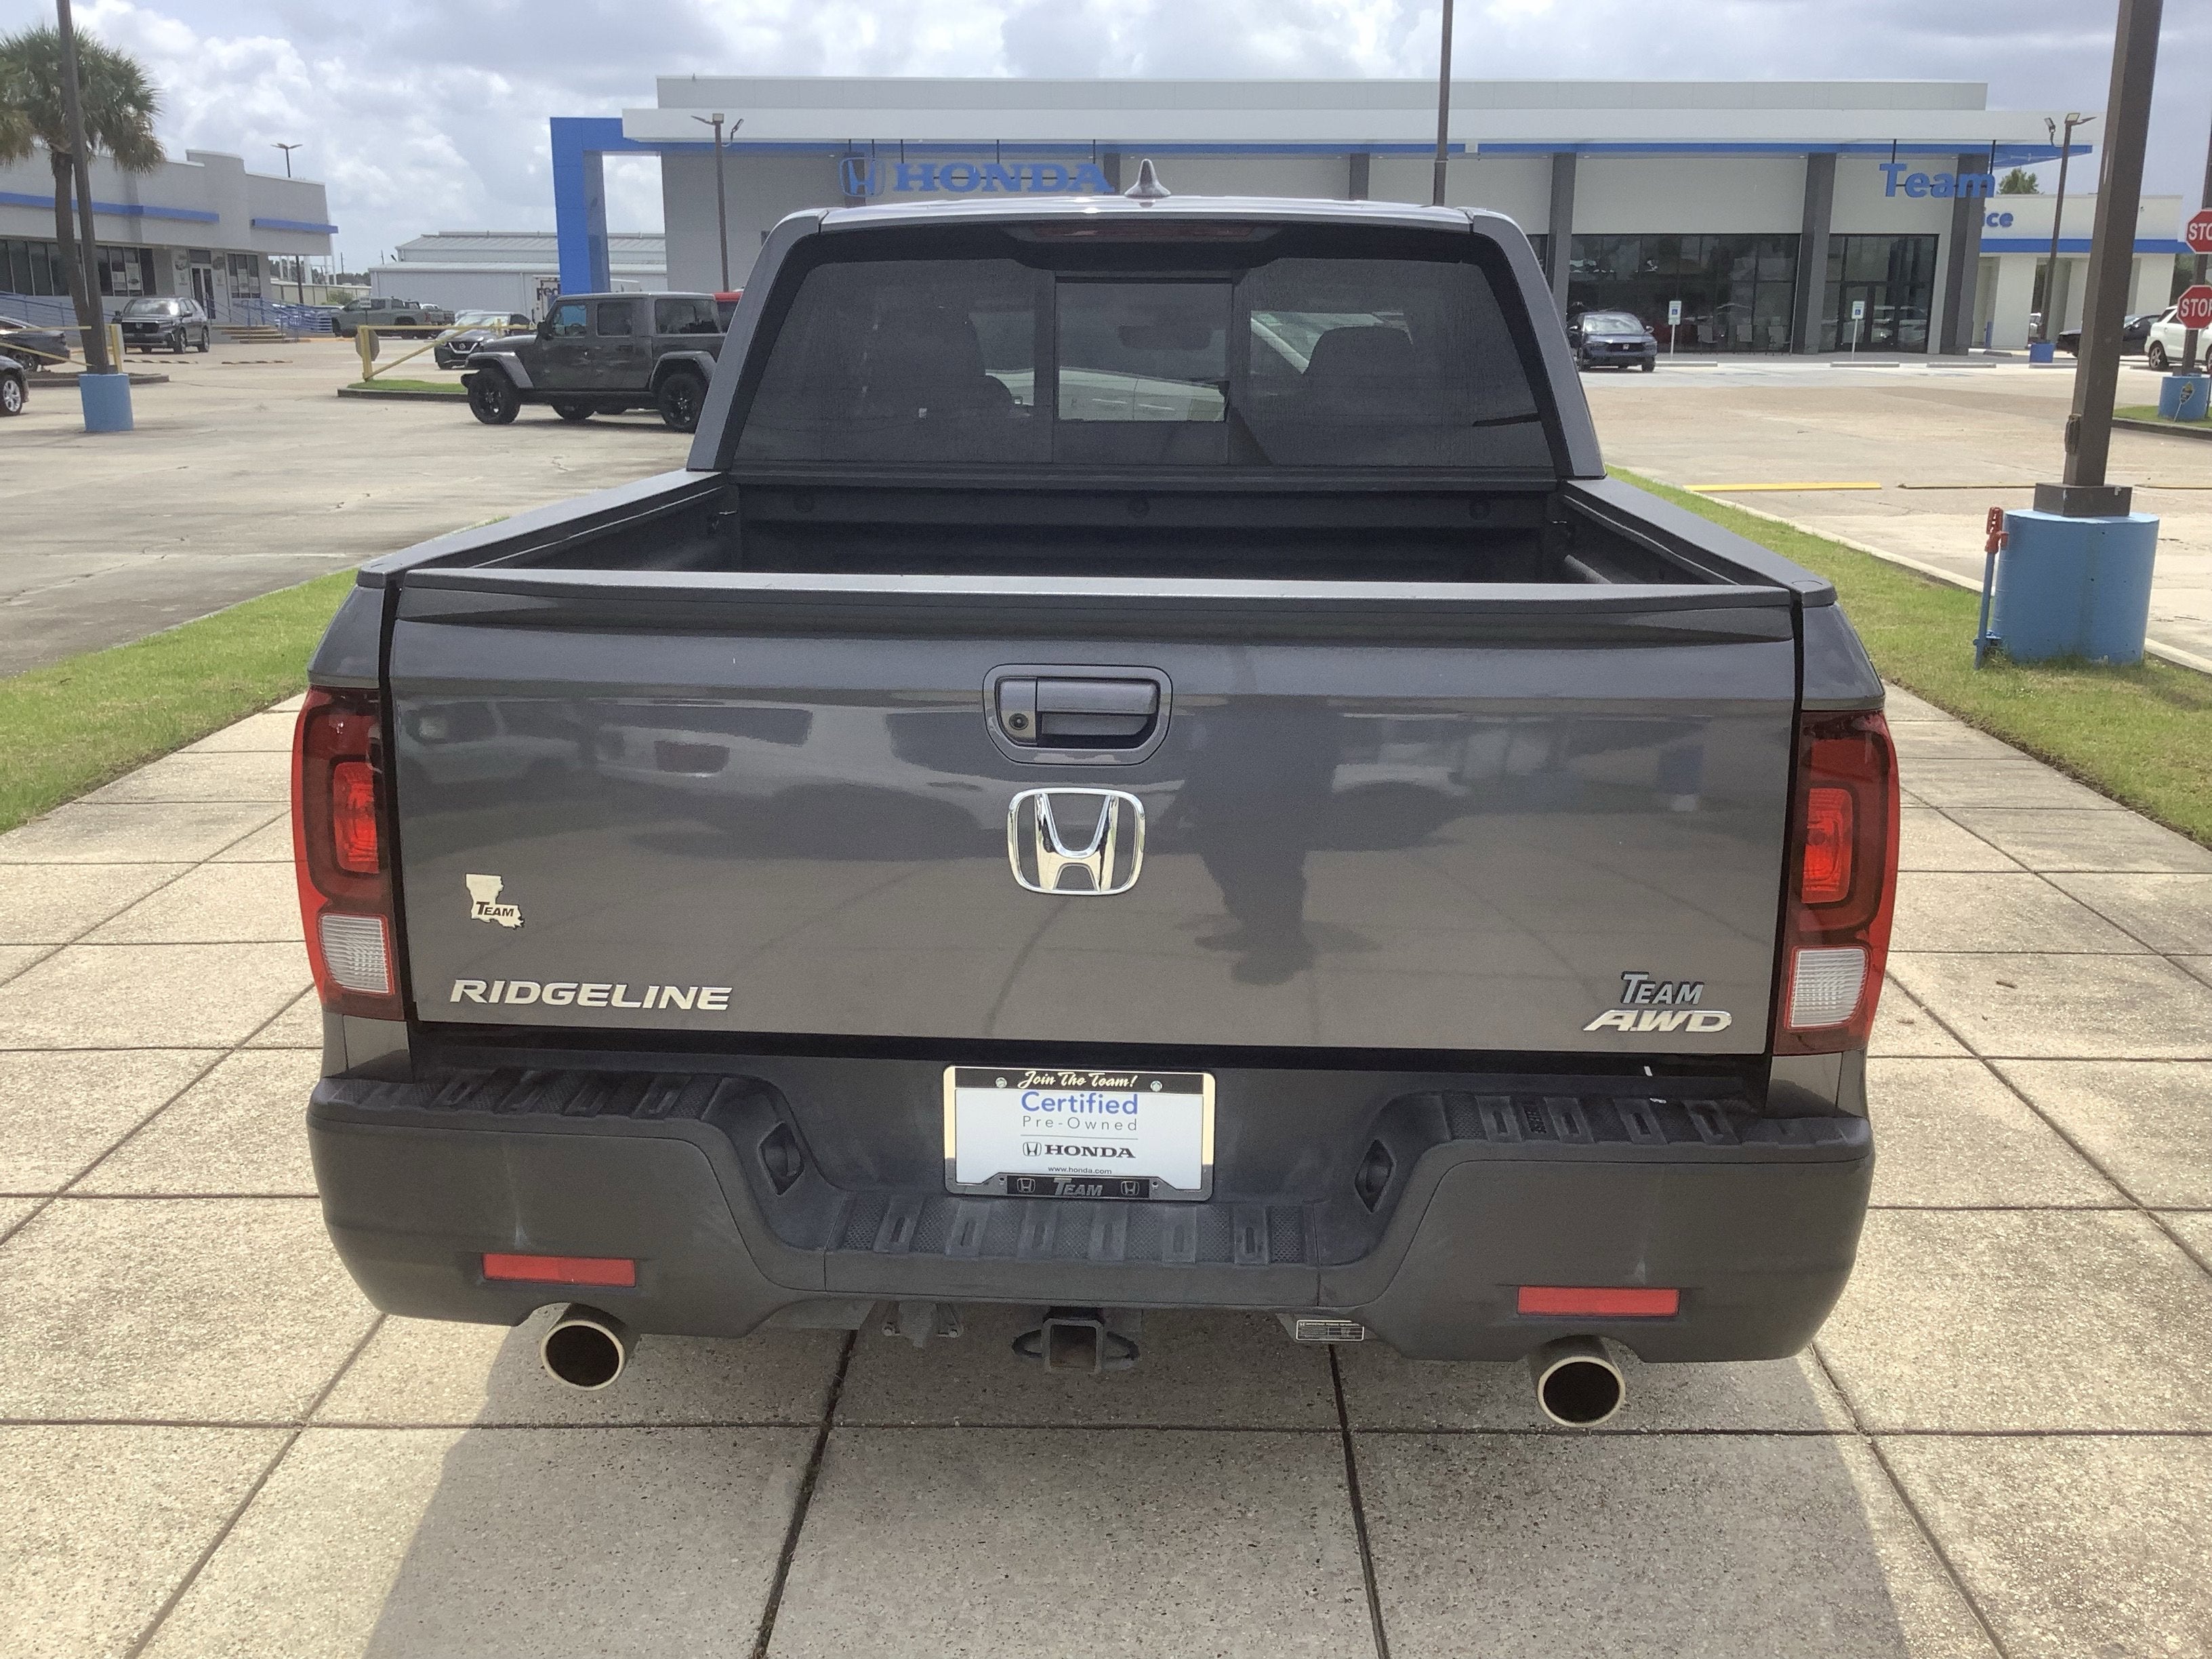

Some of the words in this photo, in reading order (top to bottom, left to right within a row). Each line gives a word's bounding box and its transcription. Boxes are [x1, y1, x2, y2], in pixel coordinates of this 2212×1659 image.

[893, 163, 1115, 192] HONDA
[1879, 163, 1995, 198] Team
[476, 901, 514, 917] TEAM
[450, 979, 733, 1010] RIDGELINE
[1620, 971, 1704, 1005] TEAM
[1583, 1009, 1732, 1032] AWD
[1018, 1071, 1056, 1089] Join
[1058, 1071, 1086, 1086] The
[1088, 1073, 1138, 1088] Team!
[1021, 1091, 1139, 1115] Certified
[1023, 1115, 1138, 1131] Pre-Owned
[1044, 1145, 1136, 1159] HONDA
[1048, 1166, 1112, 1175] www.honda.com
[1053, 1177, 1103, 1196] TEAM
